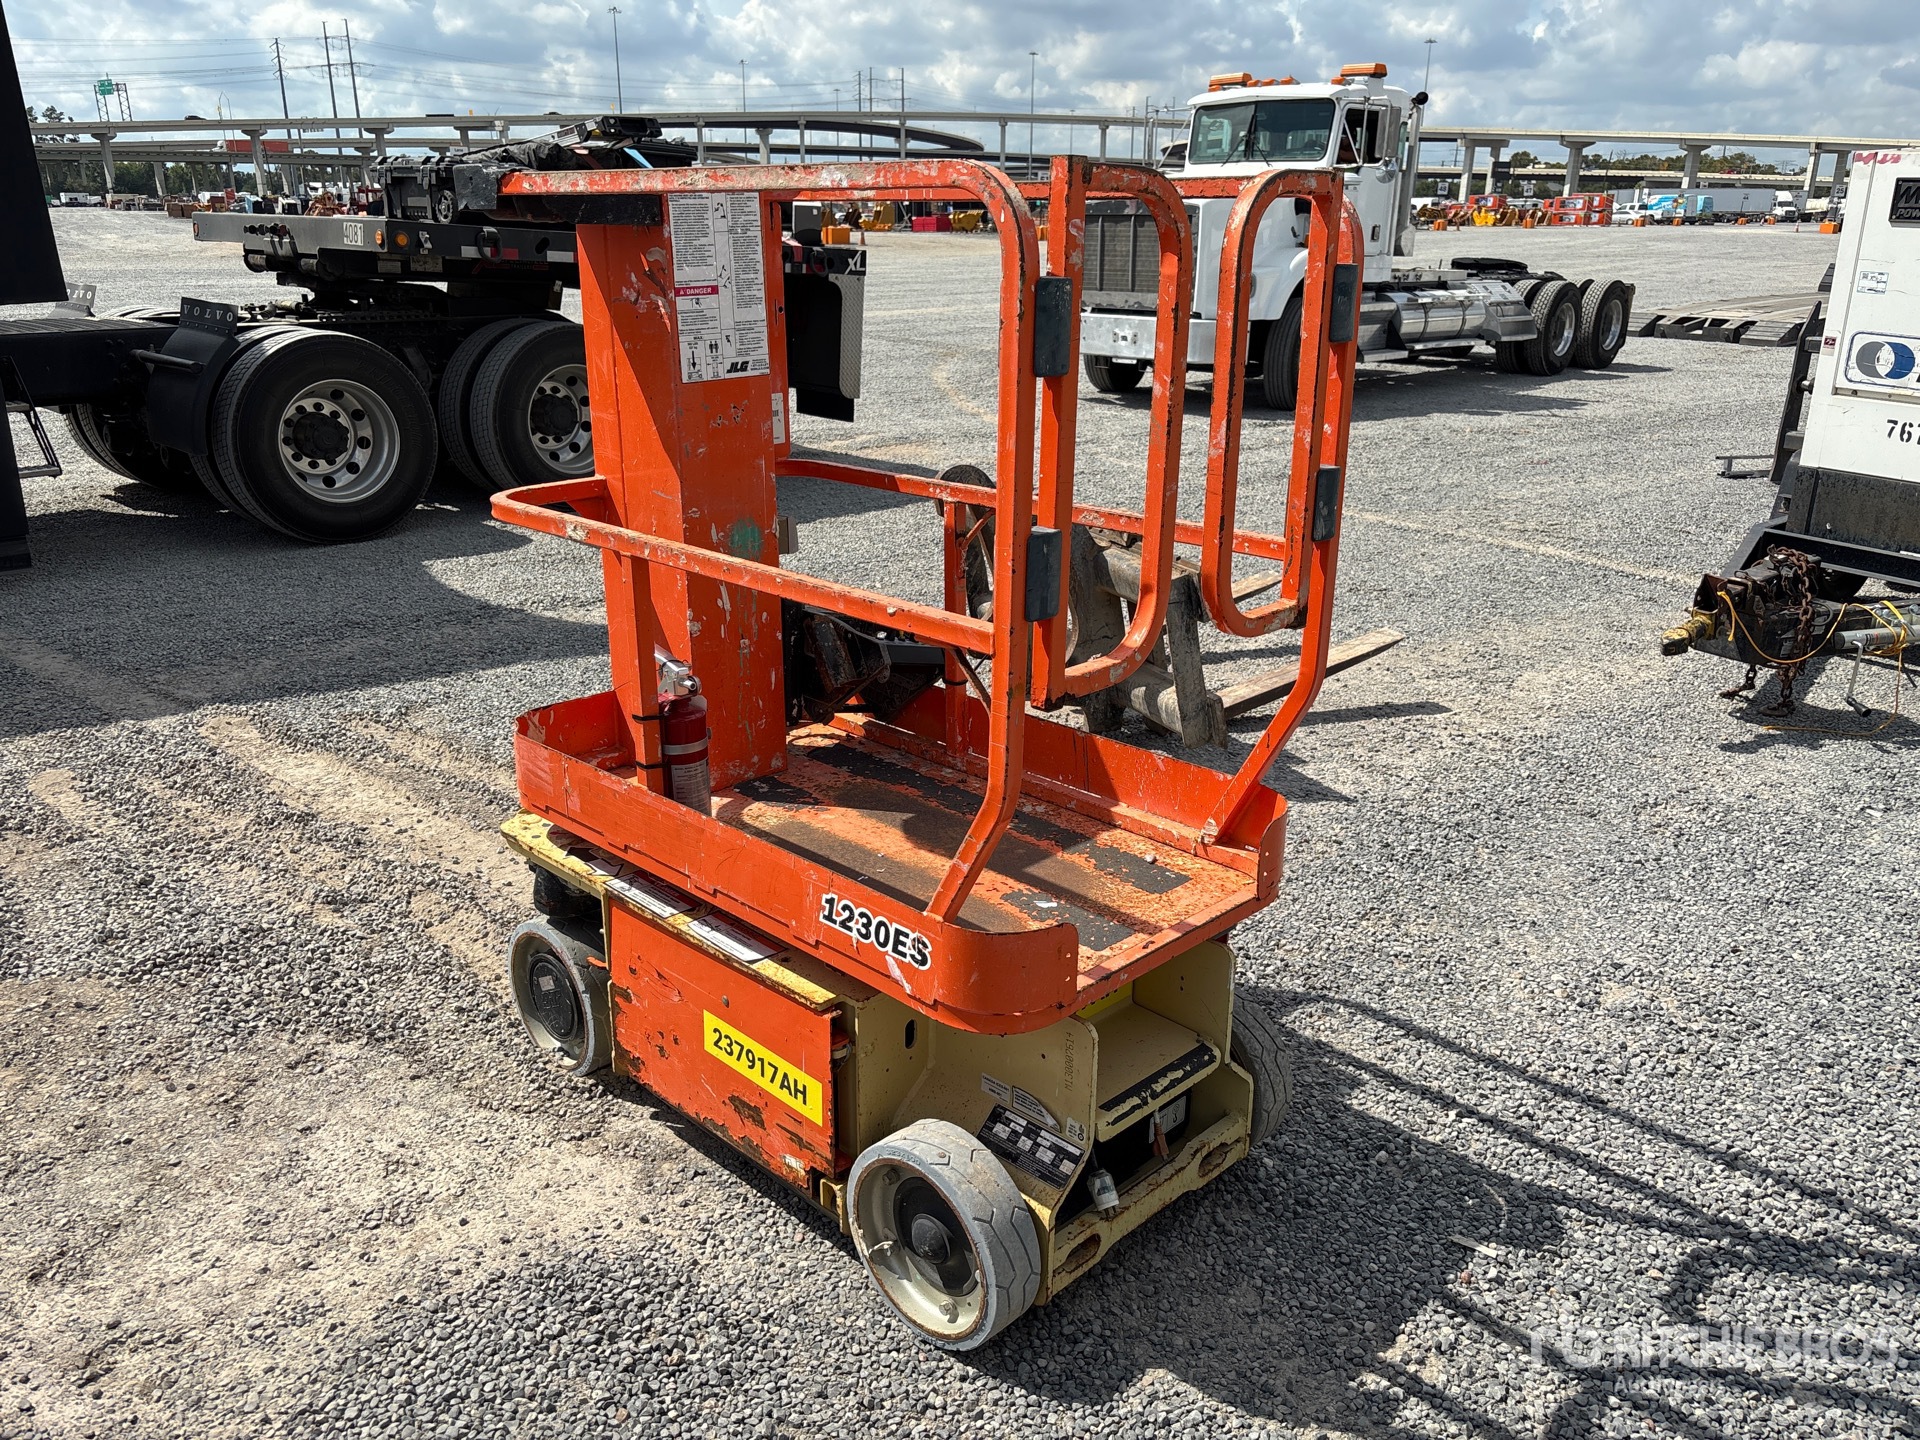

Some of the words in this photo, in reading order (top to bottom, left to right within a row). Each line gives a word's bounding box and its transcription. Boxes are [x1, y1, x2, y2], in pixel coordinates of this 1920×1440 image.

[344, 223, 363, 245] 4081
[686, 287, 712, 295] DANGER
[183, 304, 234, 322] VOLVO
[726, 361, 750, 374] JLG
[1887, 419, 1920, 445] 76
[822, 896, 929, 967] 1230ES
[713, 1027, 807, 1105] 237917AH
